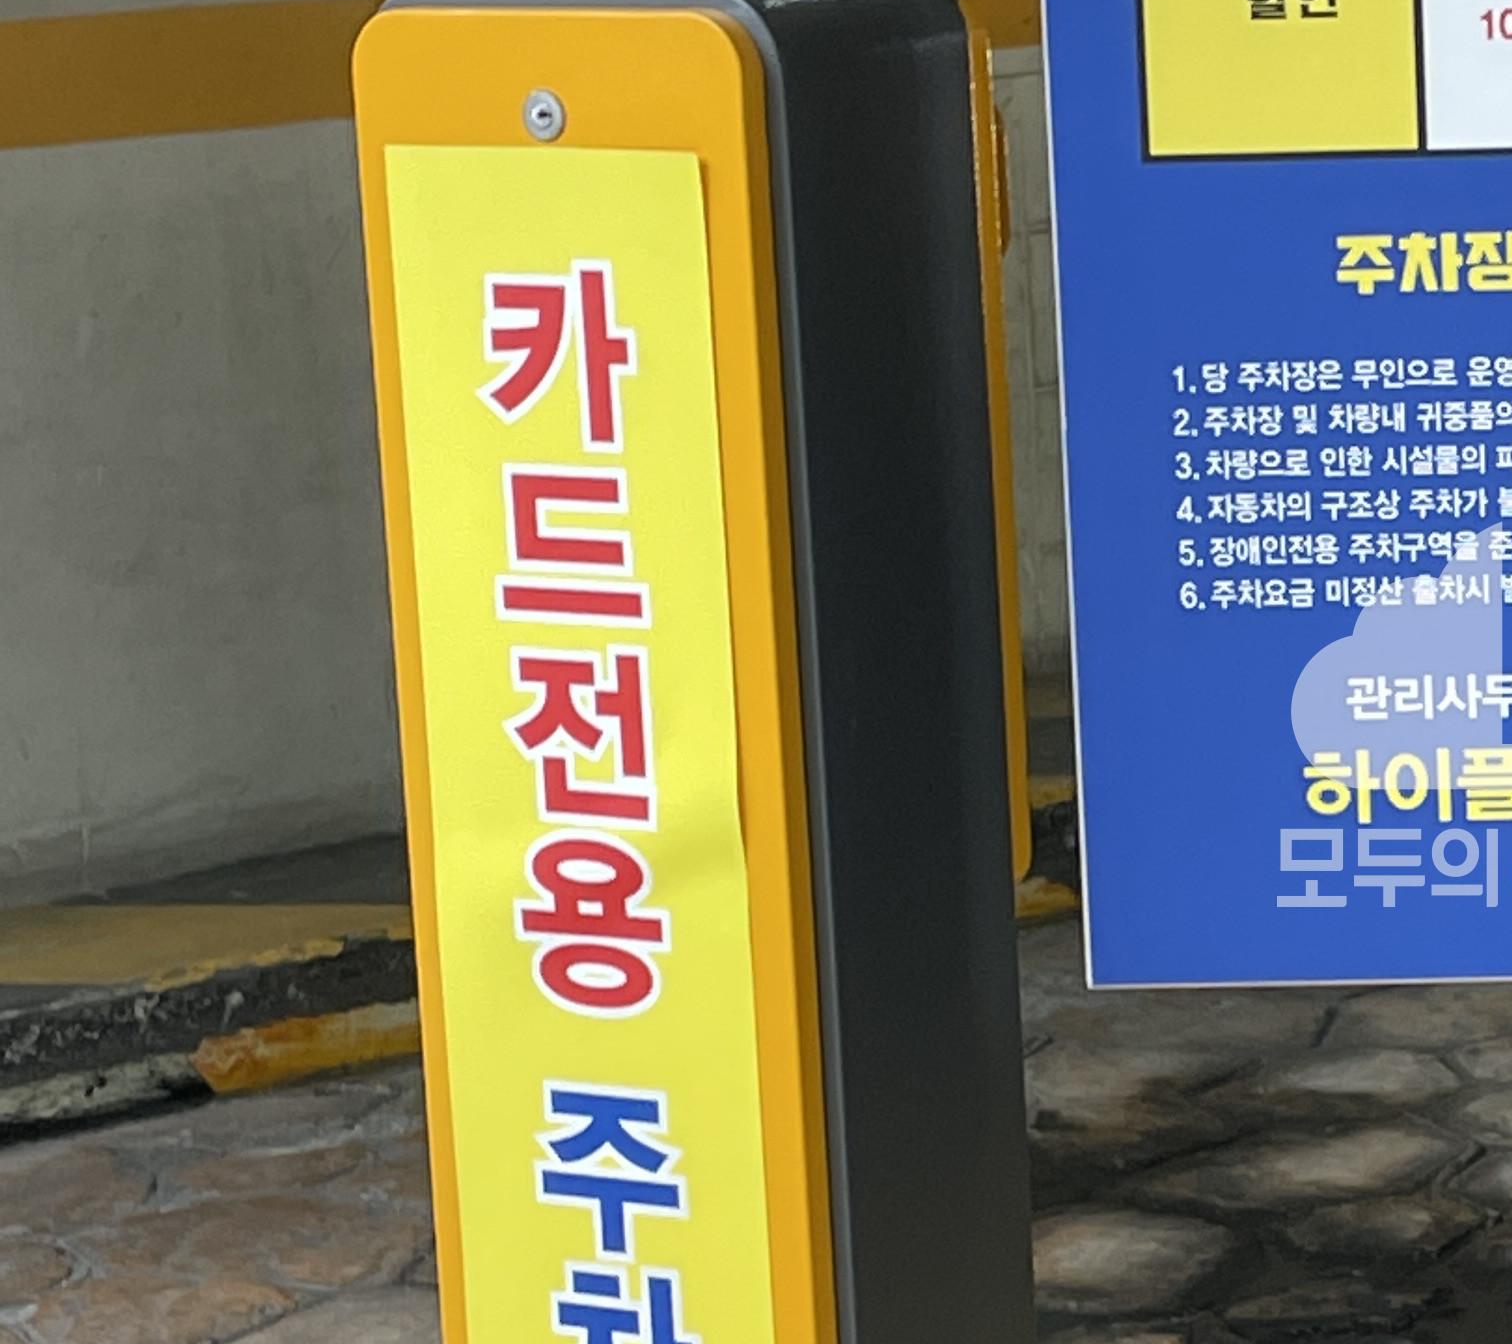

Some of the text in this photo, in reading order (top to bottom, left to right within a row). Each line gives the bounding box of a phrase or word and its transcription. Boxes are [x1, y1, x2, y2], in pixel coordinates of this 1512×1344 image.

[1239, 360, 1342, 391] 주차장은
[1353, 359, 1457, 388] 무인으로
[1293, 405, 1316, 433] 및
[1329, 403, 1405, 433] 차량내
[1322, 447, 1371, 475] 인한
[1384, 446, 1484, 474] 시설물의
[1323, 491, 1399, 518] 구조상
[1411, 489, 1486, 517] 주차가
[1351, 532, 1478, 561] 주차구역을
[1327, 578, 1403, 606] 미정산
[1413, 574, 1489, 604] 출차시
[486, 264, 664, 1010] 카드전용
